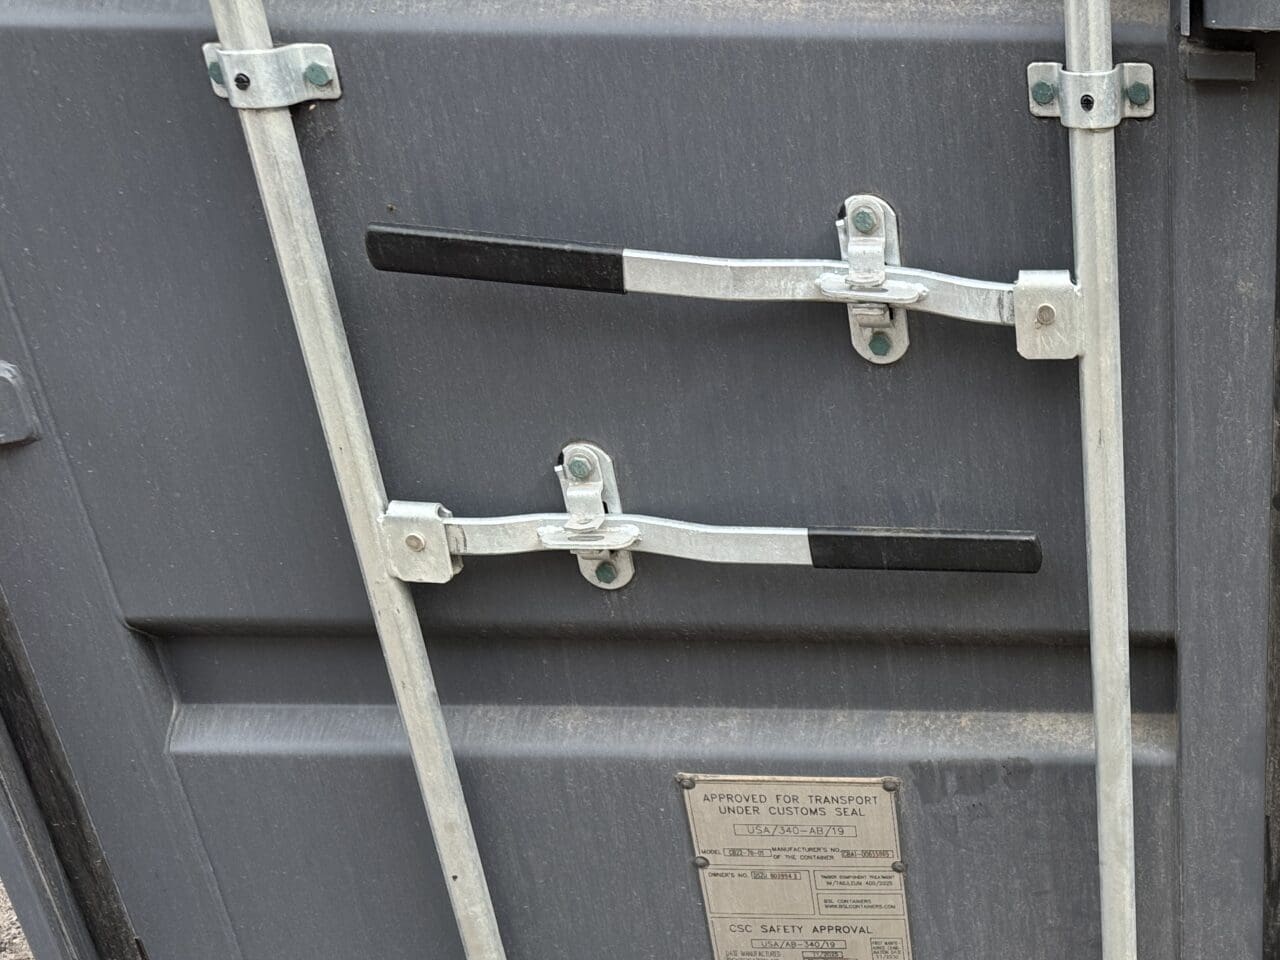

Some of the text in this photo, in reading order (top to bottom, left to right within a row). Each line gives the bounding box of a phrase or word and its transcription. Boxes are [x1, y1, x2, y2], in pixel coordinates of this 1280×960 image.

[703, 794, 878, 805] APPROVED FOR TRANSPORT
[719, 806, 865, 817] UNDER CUSTOMS SEAL
[747, 825, 845, 836] USA/340-AB/19
[729, 924, 873, 934] CSC SAFETY APPROVAL
[761, 940, 836, 949] USA/AB-340/19
